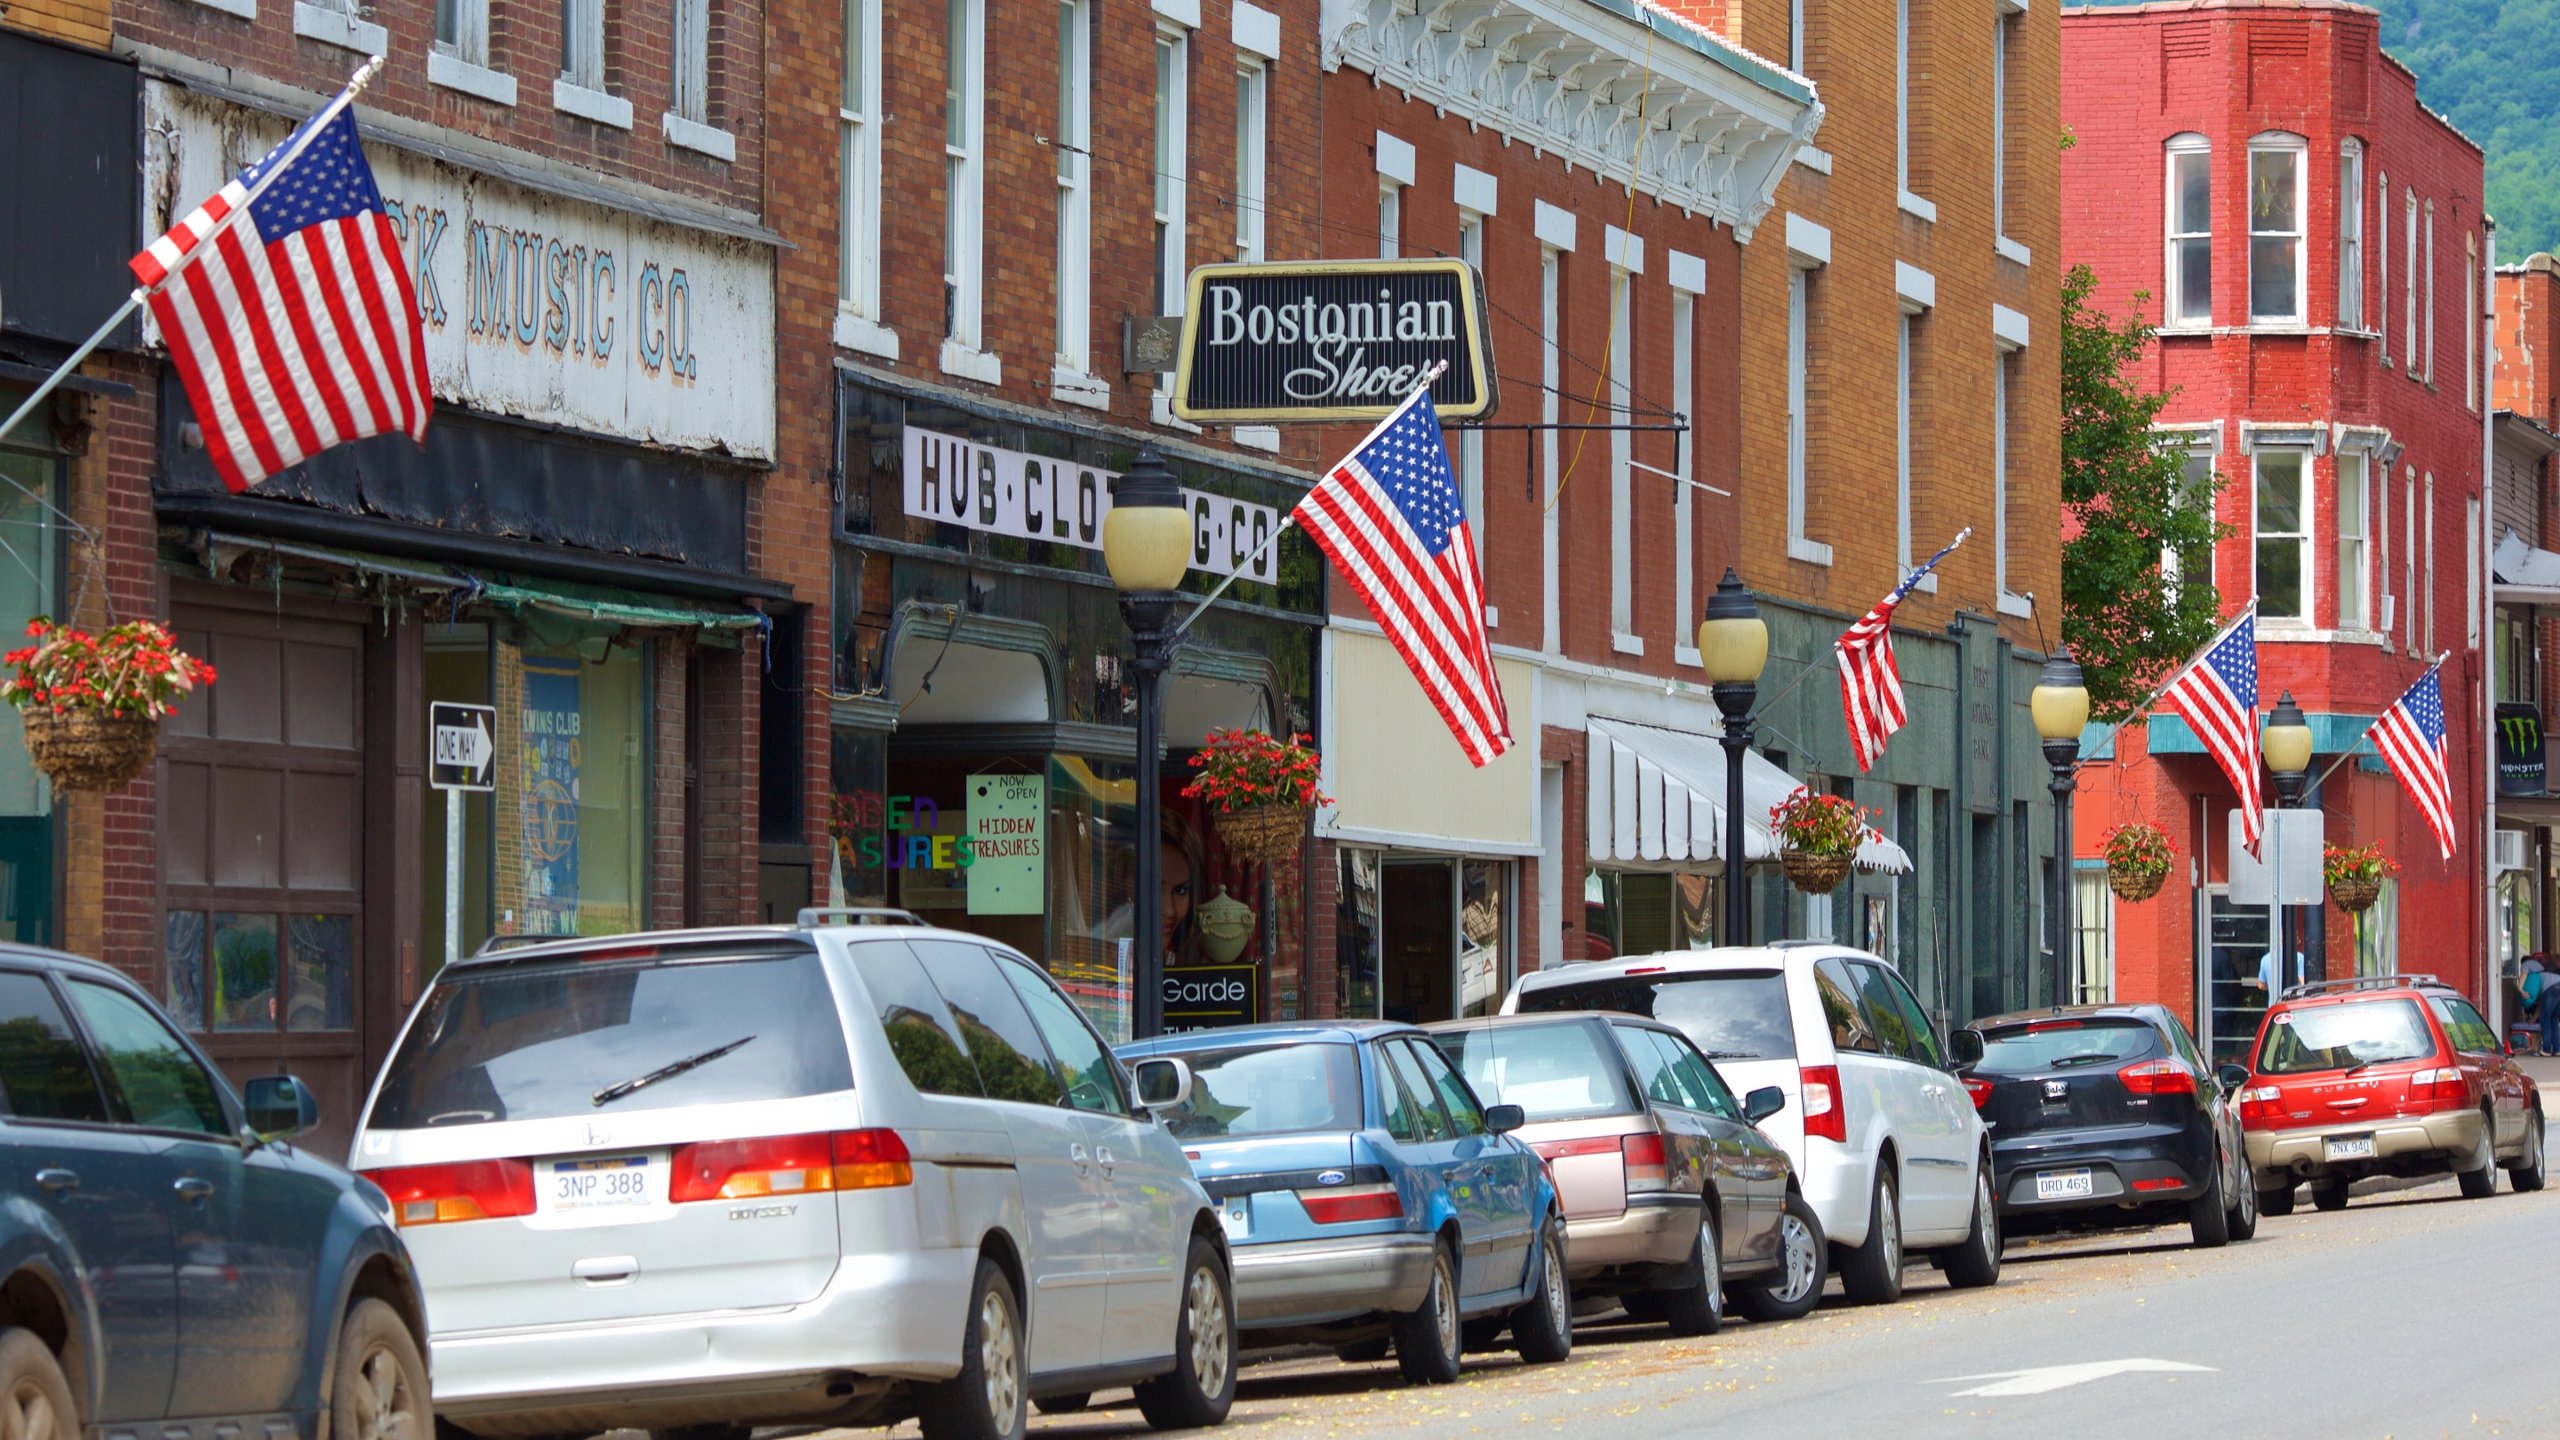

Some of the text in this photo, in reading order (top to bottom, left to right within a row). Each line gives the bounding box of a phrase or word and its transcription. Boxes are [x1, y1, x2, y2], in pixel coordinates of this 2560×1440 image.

[469, 219, 616, 364] MUSIC
[638, 260, 697, 383] CO.
[1209, 286, 1456, 346] Bostonian
[438, 730, 477, 761] ONE WAY
[2501, 763, 2544, 773] MONSTER
[999, 775, 1026, 788] NOW
[1006, 787, 1038, 800] OPEN
[979, 817, 1036, 835] HIDDEN
[838, 834, 976, 870] ASURES
[971, 838, 1041, 859] TREASURES
[1162, 976, 1246, 1003] Garde
[558, 1171, 644, 1198] 3NP 388
[2067, 1177, 2089, 1190] 469
[729, 1205, 798, 1221] ODYSSEY
